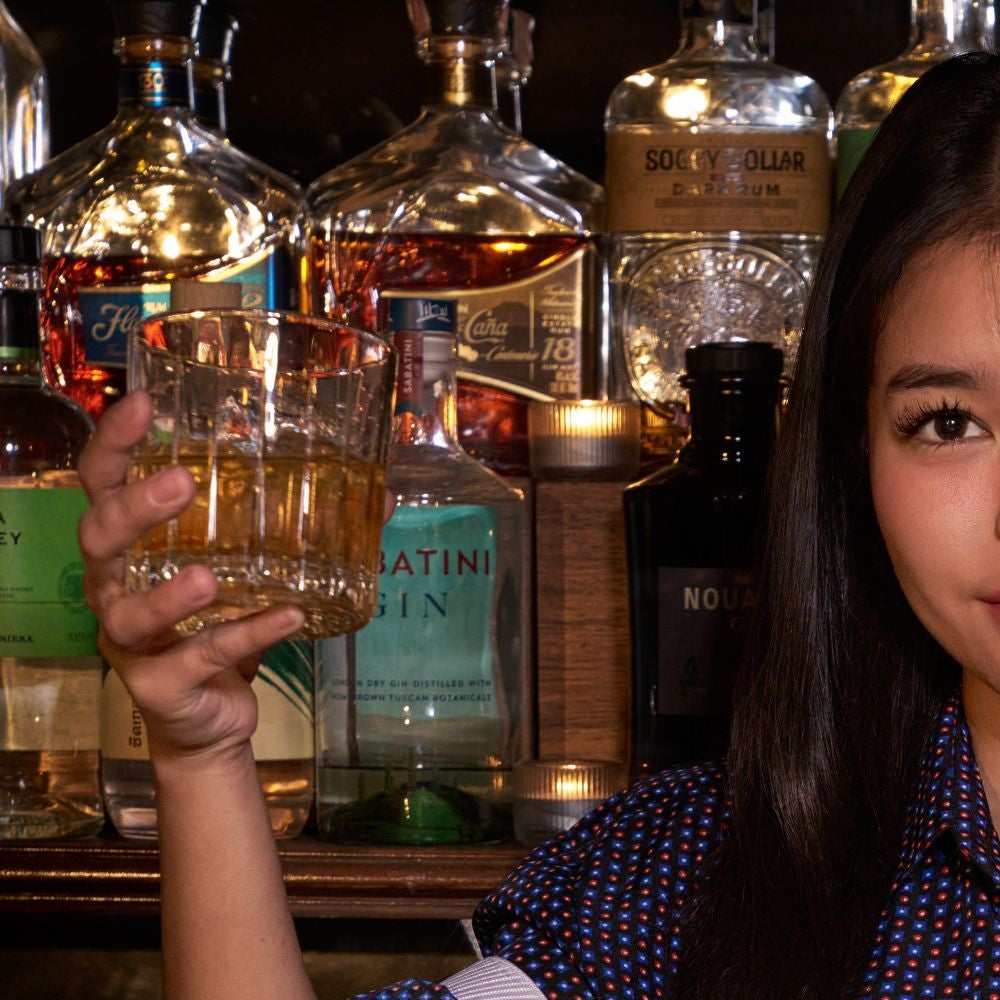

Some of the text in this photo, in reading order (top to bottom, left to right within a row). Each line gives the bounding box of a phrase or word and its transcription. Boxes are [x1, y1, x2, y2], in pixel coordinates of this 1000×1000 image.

[726, 148, 805, 172] OLLAR
[464, 308, 510, 343] Caña
[541, 336, 577, 362] 18
[403, 339, 413, 394] SABATINI
[367, 679, 385, 688] DRY
[390, 679, 409, 688] GIN
[413, 679, 465, 688] DISTILLED
[469, 678, 492, 688] WITH
